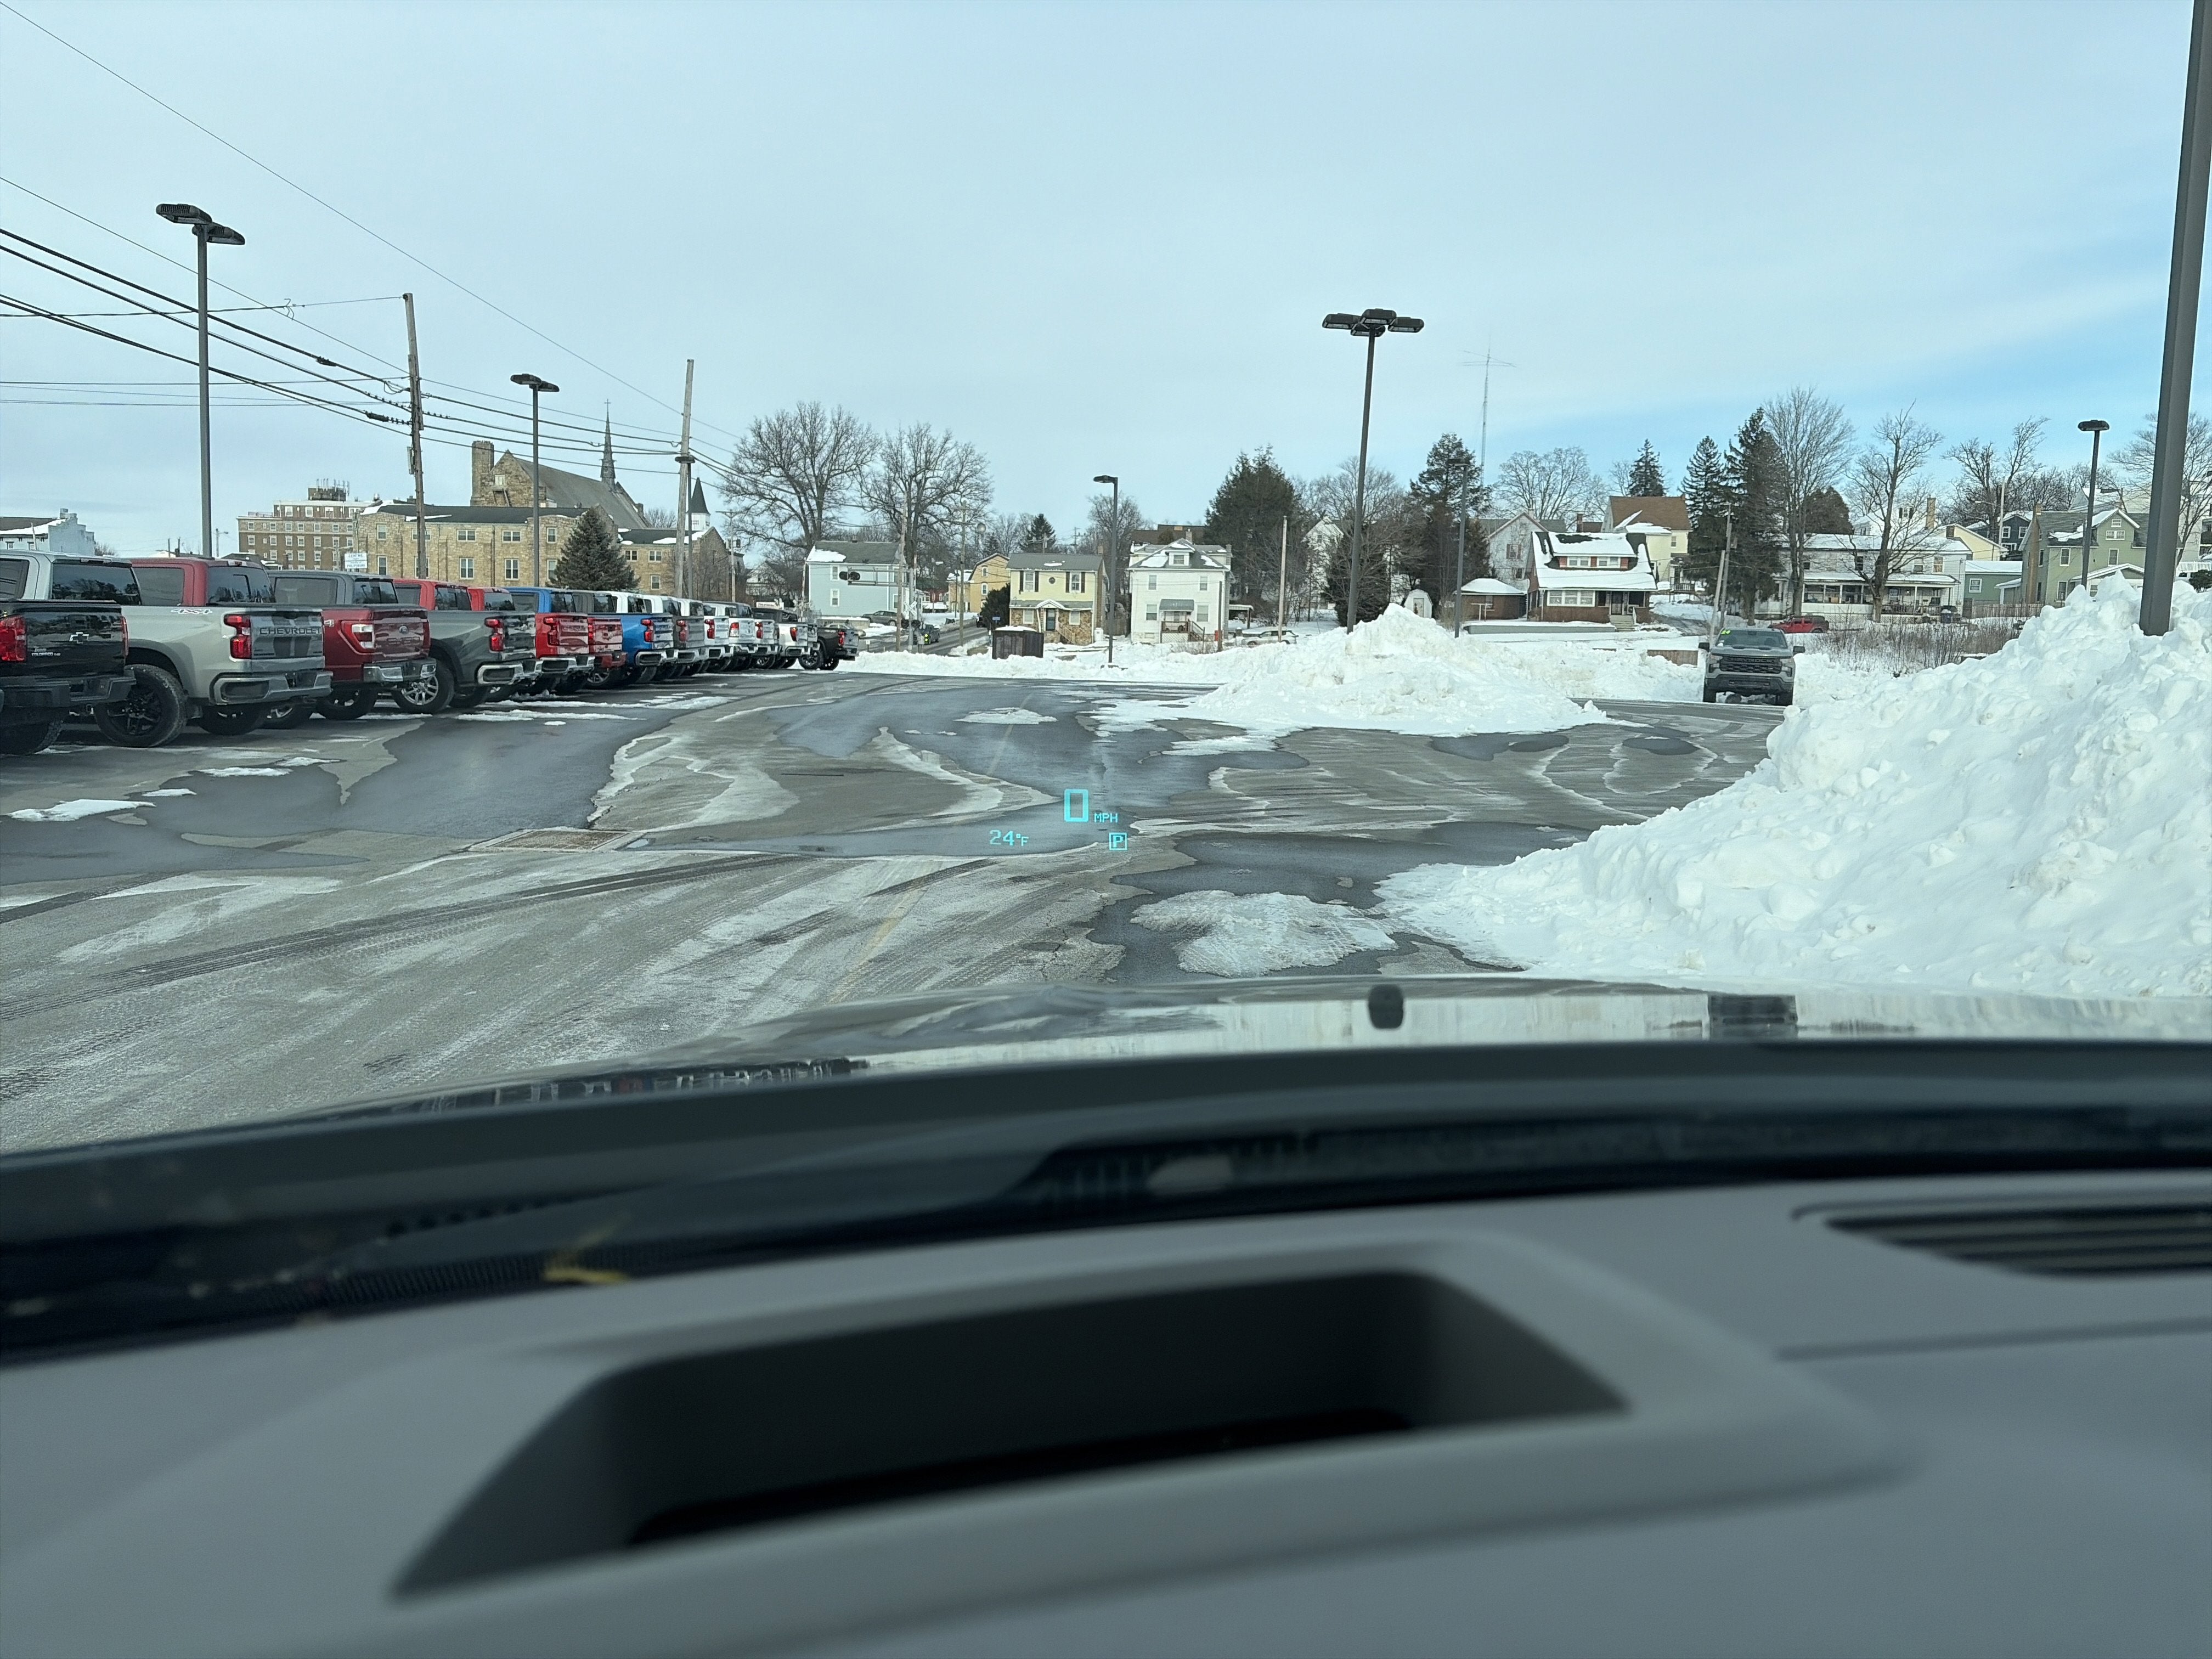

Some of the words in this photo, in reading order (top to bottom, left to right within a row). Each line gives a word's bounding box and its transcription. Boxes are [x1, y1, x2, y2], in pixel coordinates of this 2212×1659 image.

[259, 627, 321, 635] CHEVROLET
[1064, 789, 1089, 822] 0
[1094, 812, 1118, 823] MPH
[1112, 835, 1124, 848] P
